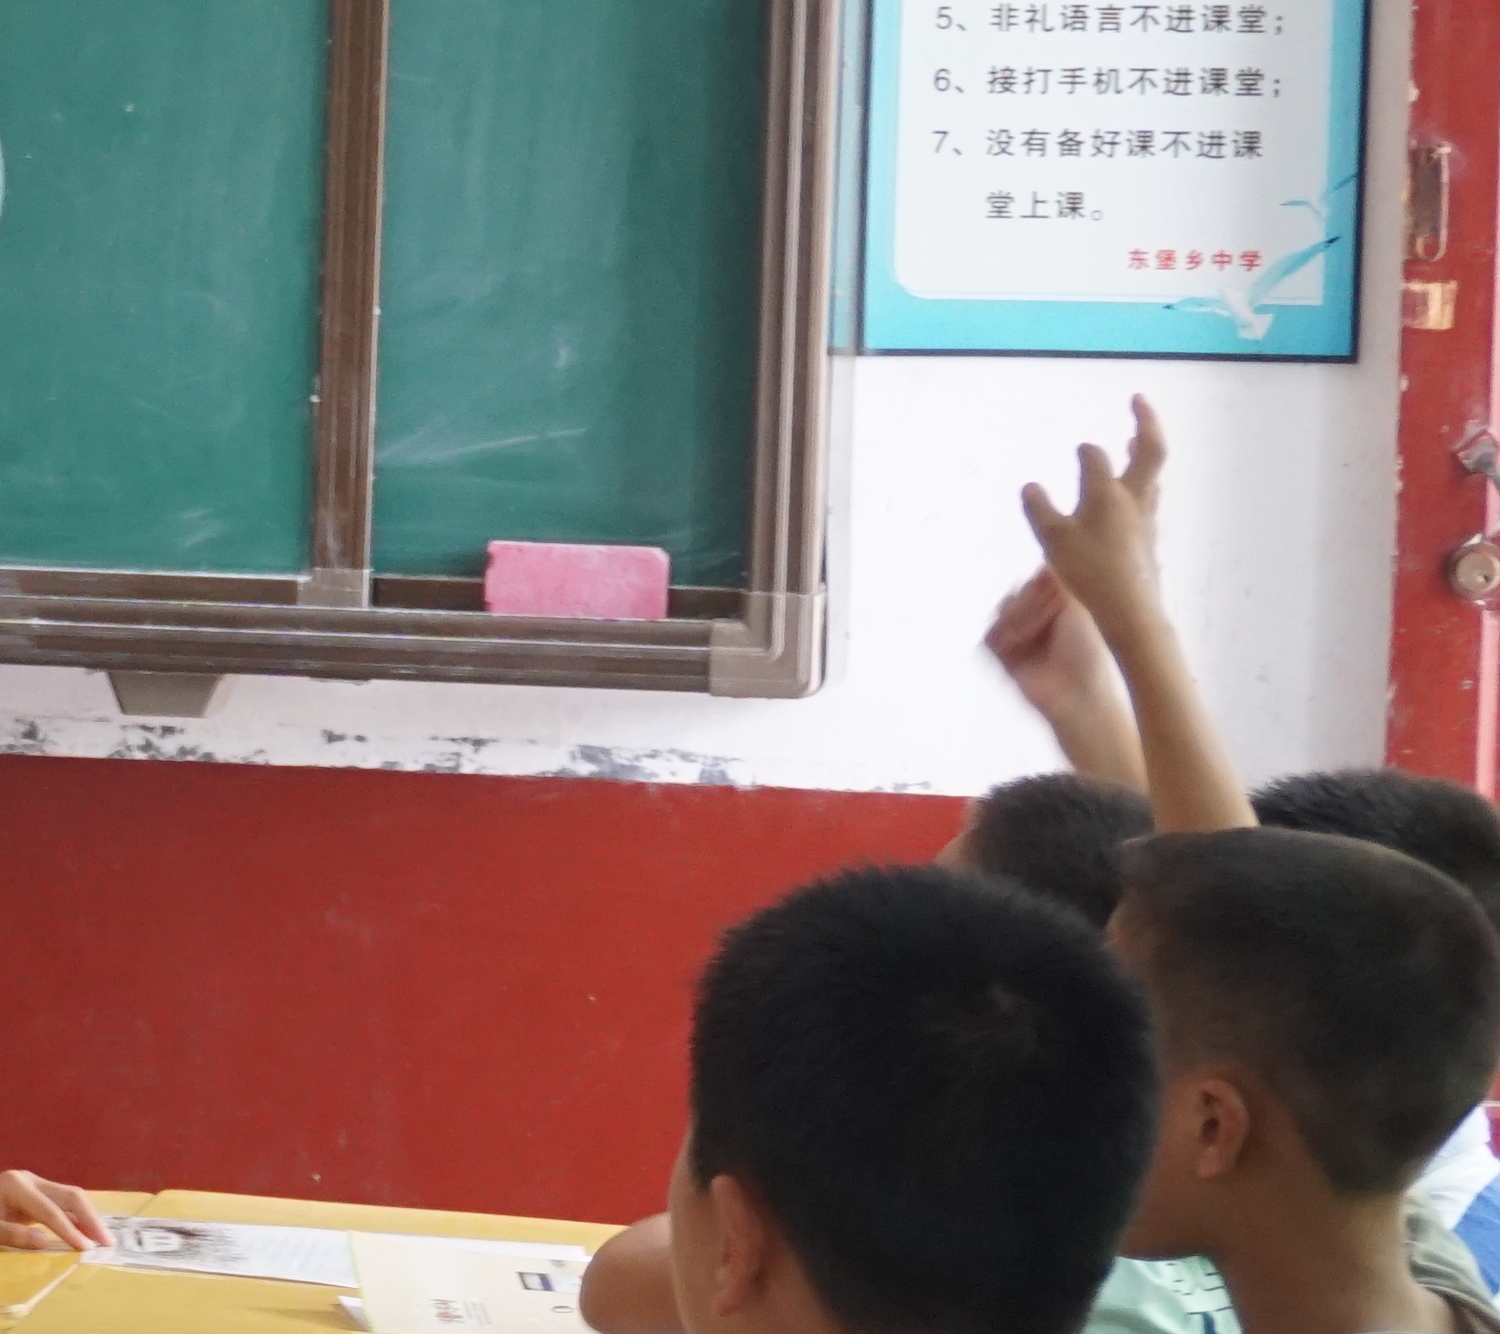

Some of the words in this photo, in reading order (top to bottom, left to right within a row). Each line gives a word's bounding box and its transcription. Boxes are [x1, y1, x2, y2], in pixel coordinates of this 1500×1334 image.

[931, 129, 1264, 160] 7、没有备好课不进课
[985, 189, 1105, 223] 堂上课。
[1127, 249, 1263, 272] 东堡乡中学
